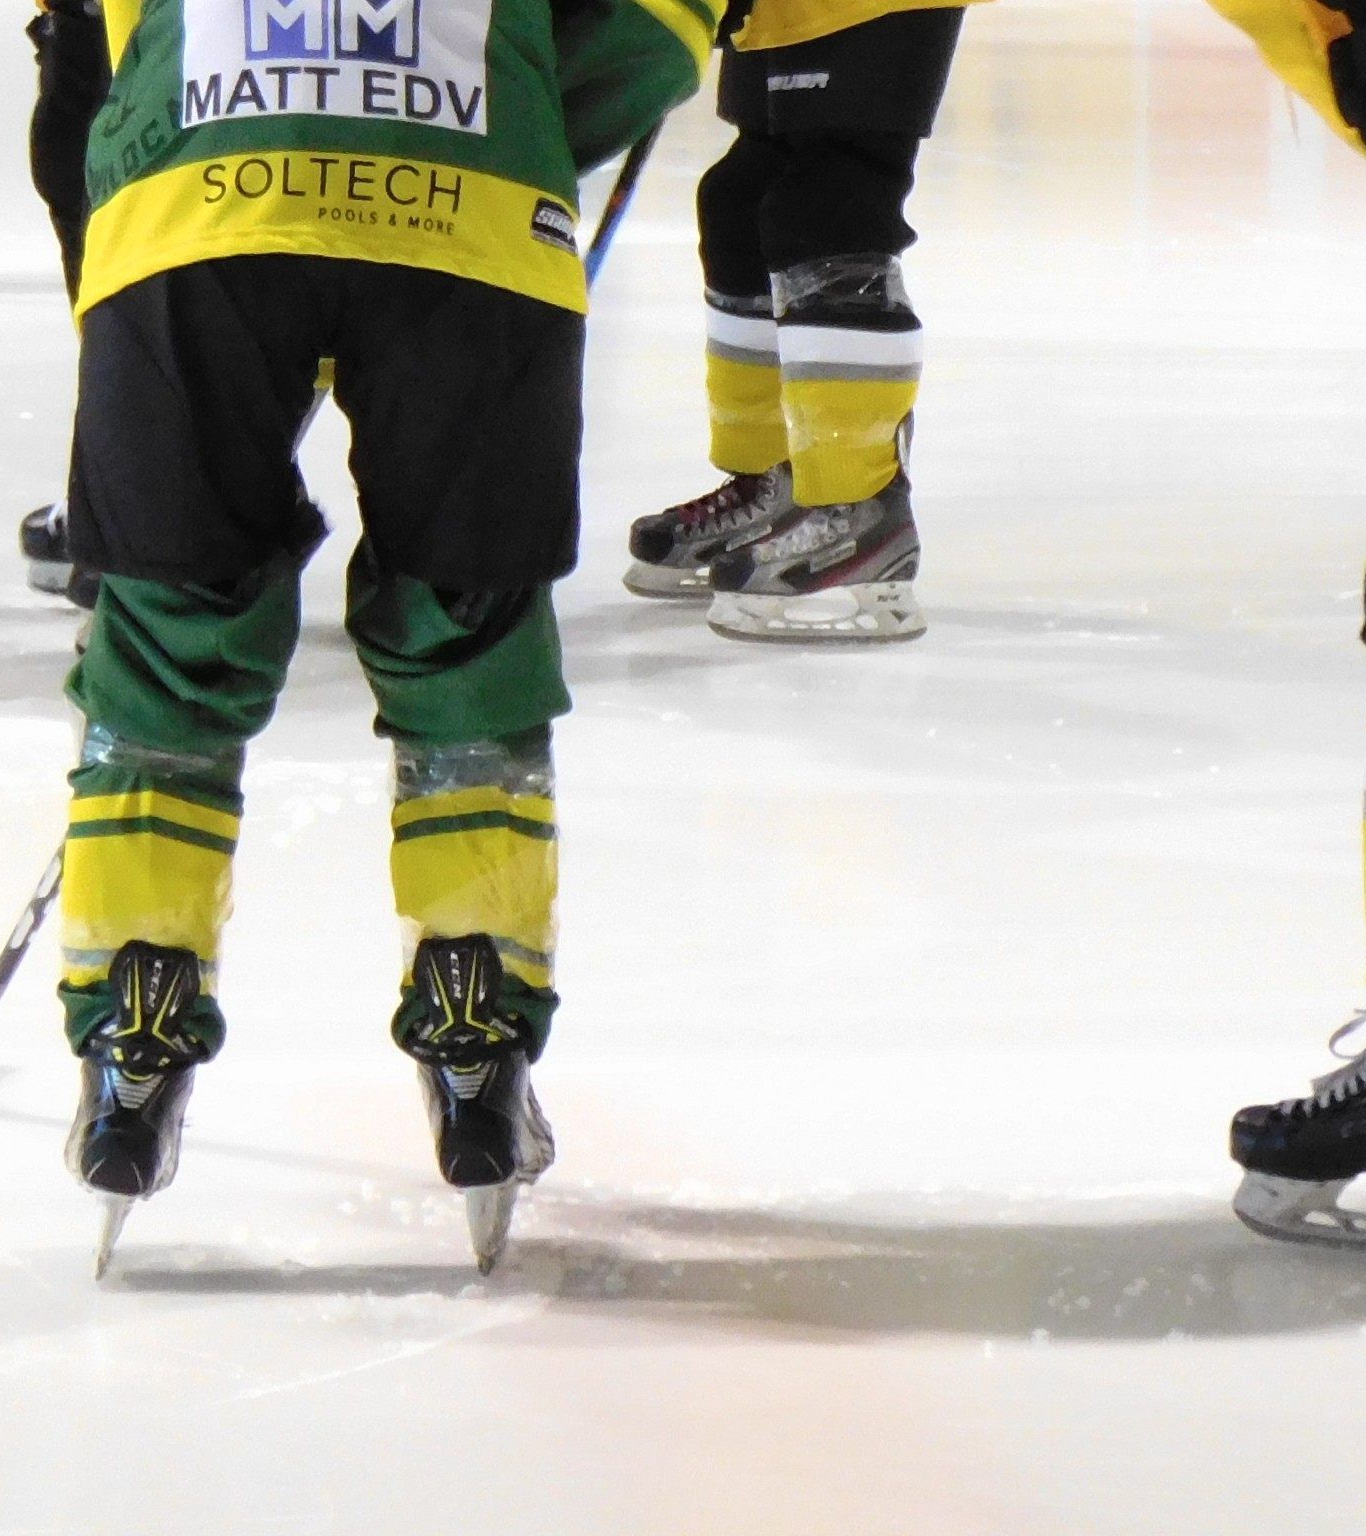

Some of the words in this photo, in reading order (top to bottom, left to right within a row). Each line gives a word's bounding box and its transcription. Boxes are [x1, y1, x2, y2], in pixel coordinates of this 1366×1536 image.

[183, 66, 342, 125] MATT
[362, 69, 483, 128] EDV
[202, 156, 463, 214] SOLTECH
[317, 206, 379, 225] POOLS
[407, 215, 456, 235] MORE
